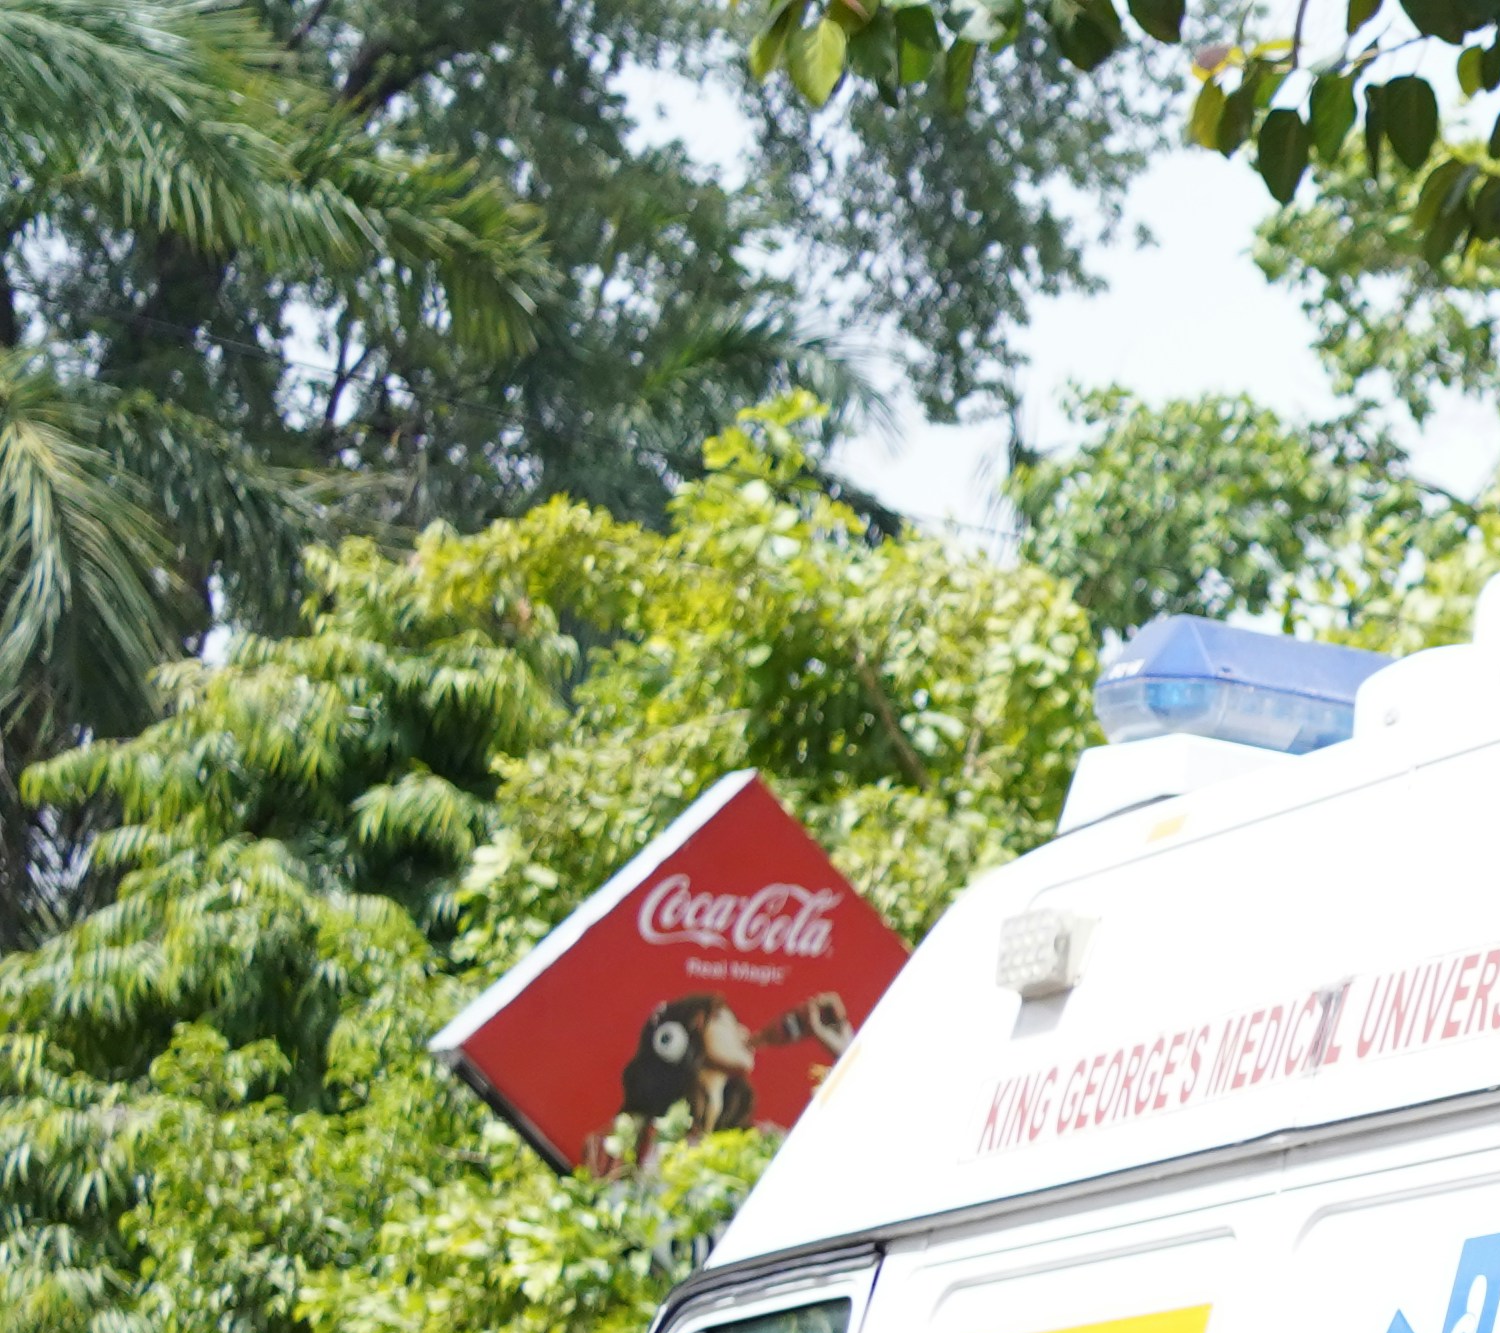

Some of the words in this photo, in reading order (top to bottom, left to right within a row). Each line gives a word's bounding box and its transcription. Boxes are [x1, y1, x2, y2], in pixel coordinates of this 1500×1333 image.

[977, 1066, 1059, 1155] KING
[1056, 1023, 1210, 1136] GEORGE'S
[1205, 981, 1352, 1099] MEDICAL
